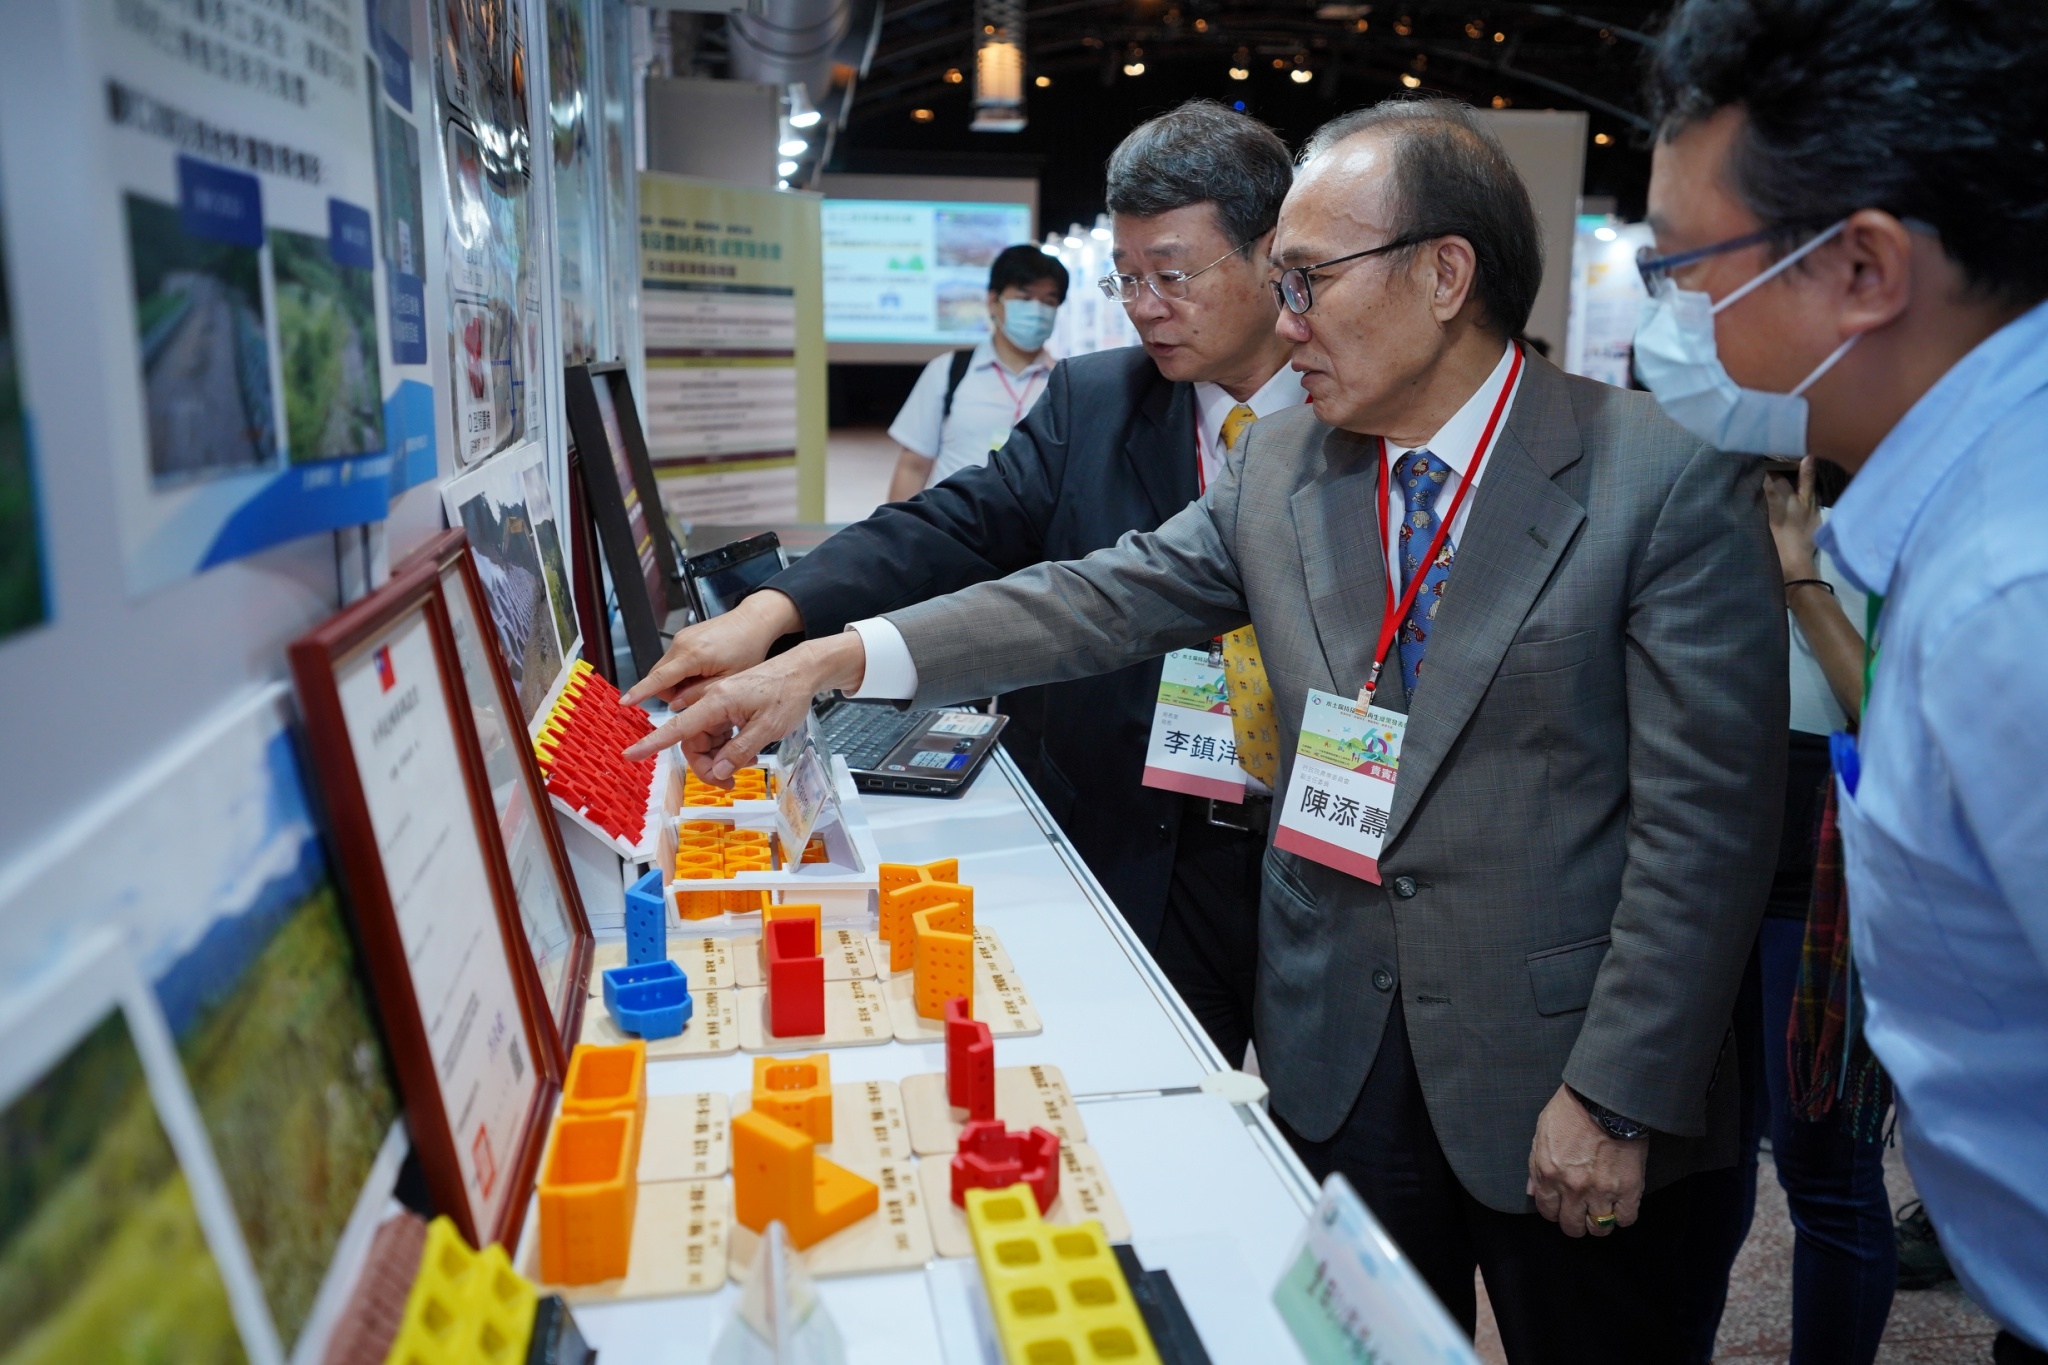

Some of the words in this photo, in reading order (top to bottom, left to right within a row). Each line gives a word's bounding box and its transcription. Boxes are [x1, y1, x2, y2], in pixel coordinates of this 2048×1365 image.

[1164, 730, 1239, 765] 李鎮洋
[1300, 785, 1390, 839] 陳添壽
